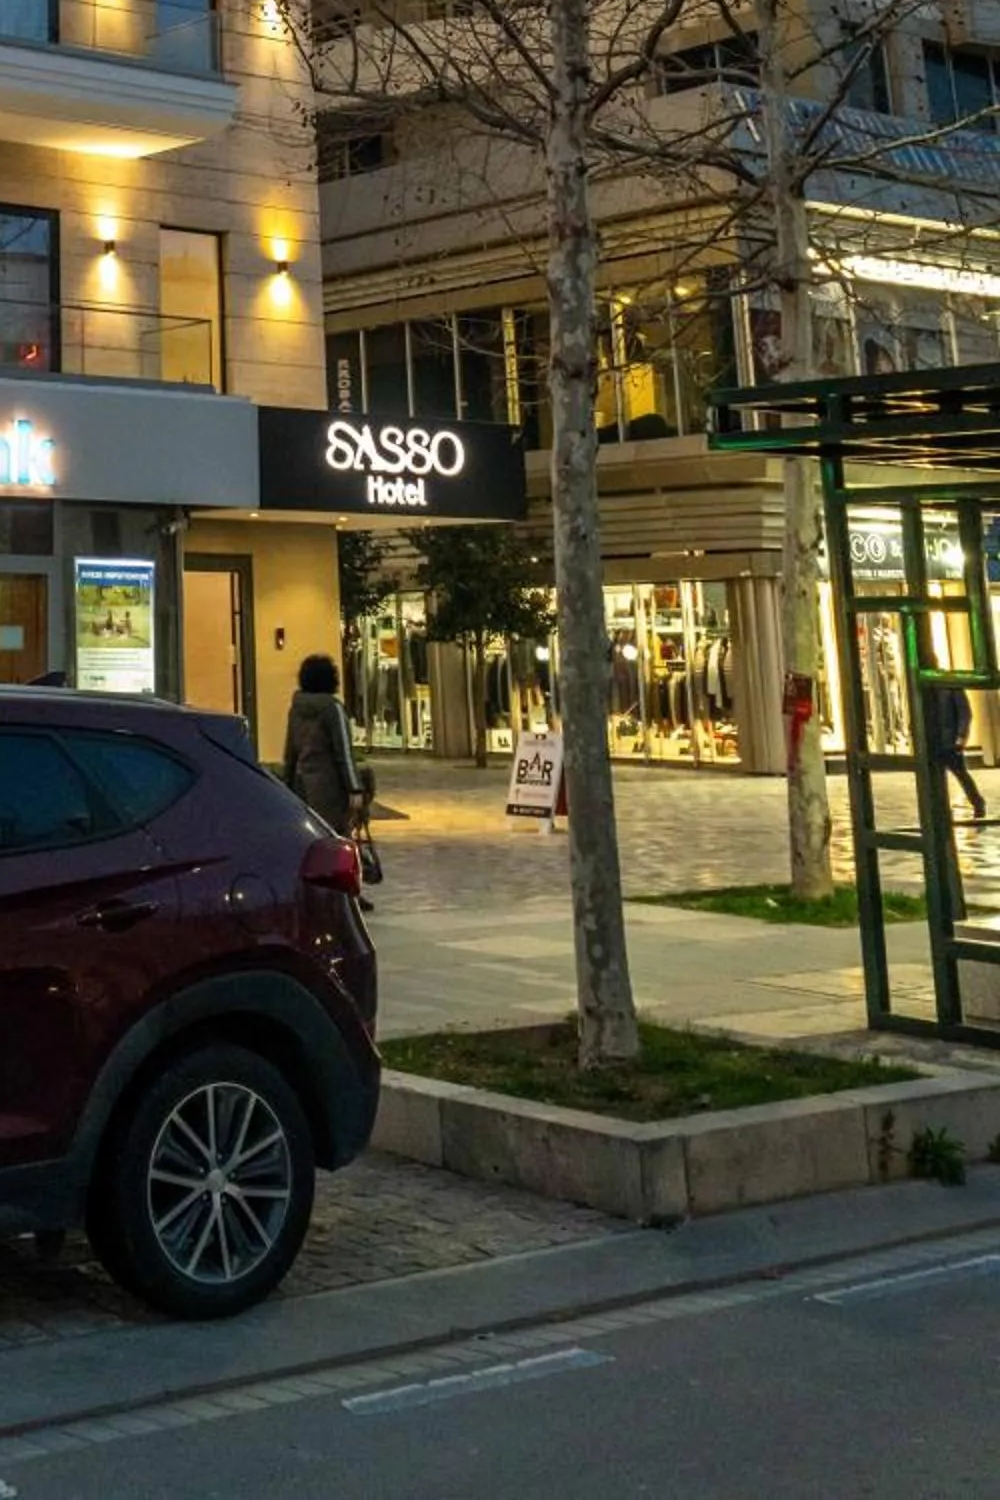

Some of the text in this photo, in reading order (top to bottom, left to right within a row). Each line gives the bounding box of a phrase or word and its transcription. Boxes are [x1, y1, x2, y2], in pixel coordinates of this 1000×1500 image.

[326, 421, 465, 477] SASSO
[367, 475, 427, 506] Hotel
[517, 752, 553, 781] BAR
